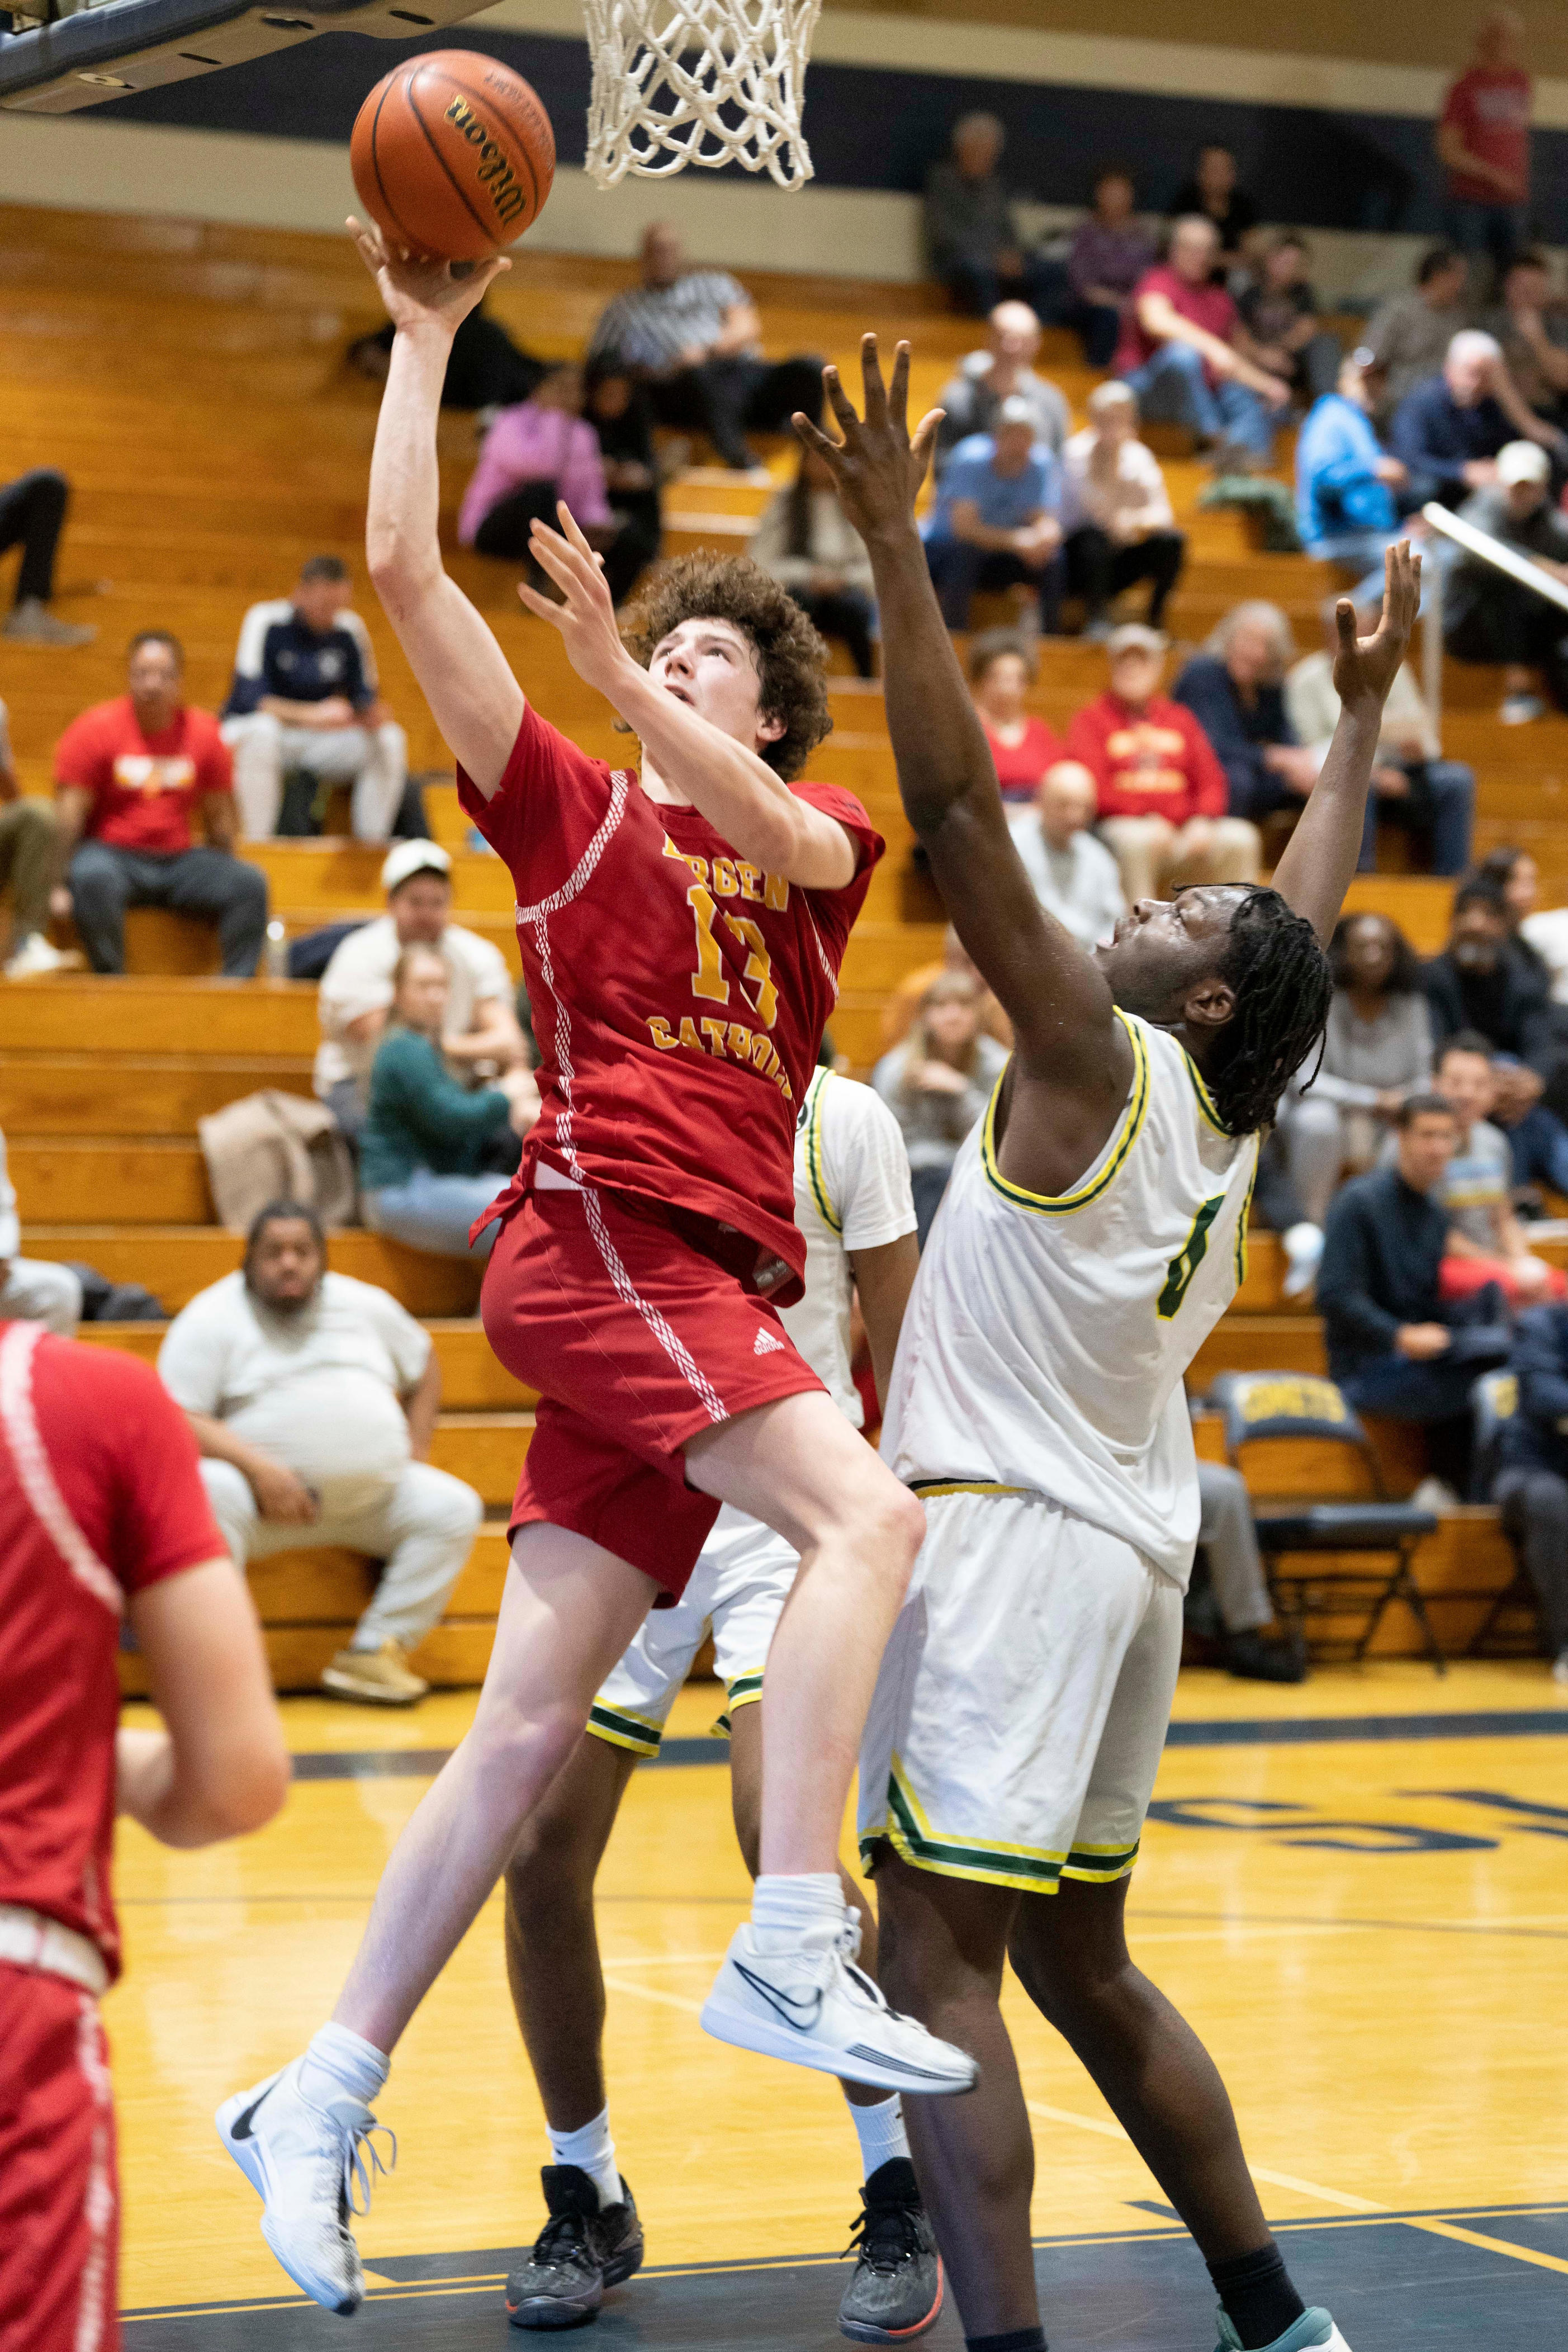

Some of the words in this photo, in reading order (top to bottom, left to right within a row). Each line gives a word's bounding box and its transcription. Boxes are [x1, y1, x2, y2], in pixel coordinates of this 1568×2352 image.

[444, 94, 527, 225] Wilson
[687, 884, 779, 1030] 13
[753, 1341, 785, 1356] adidas
